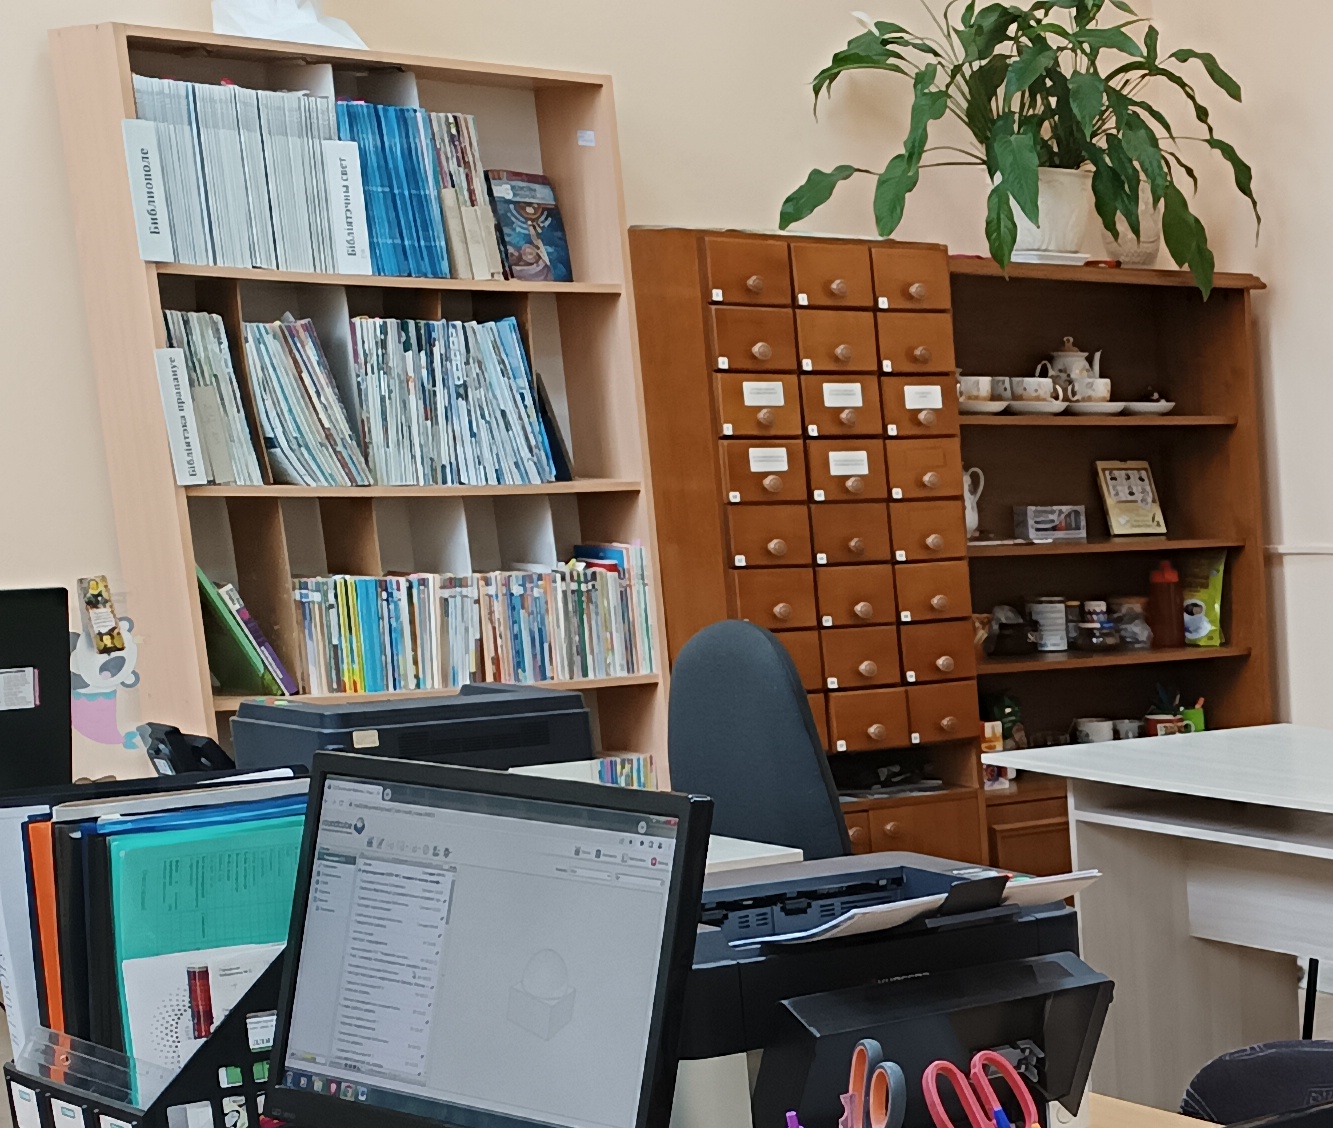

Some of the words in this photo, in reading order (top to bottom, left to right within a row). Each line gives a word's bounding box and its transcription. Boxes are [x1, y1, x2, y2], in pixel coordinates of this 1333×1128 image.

[140, 147, 161, 235] Библиополе
[338, 157, 349, 182] свет
[168, 356, 186, 412] прапануе
